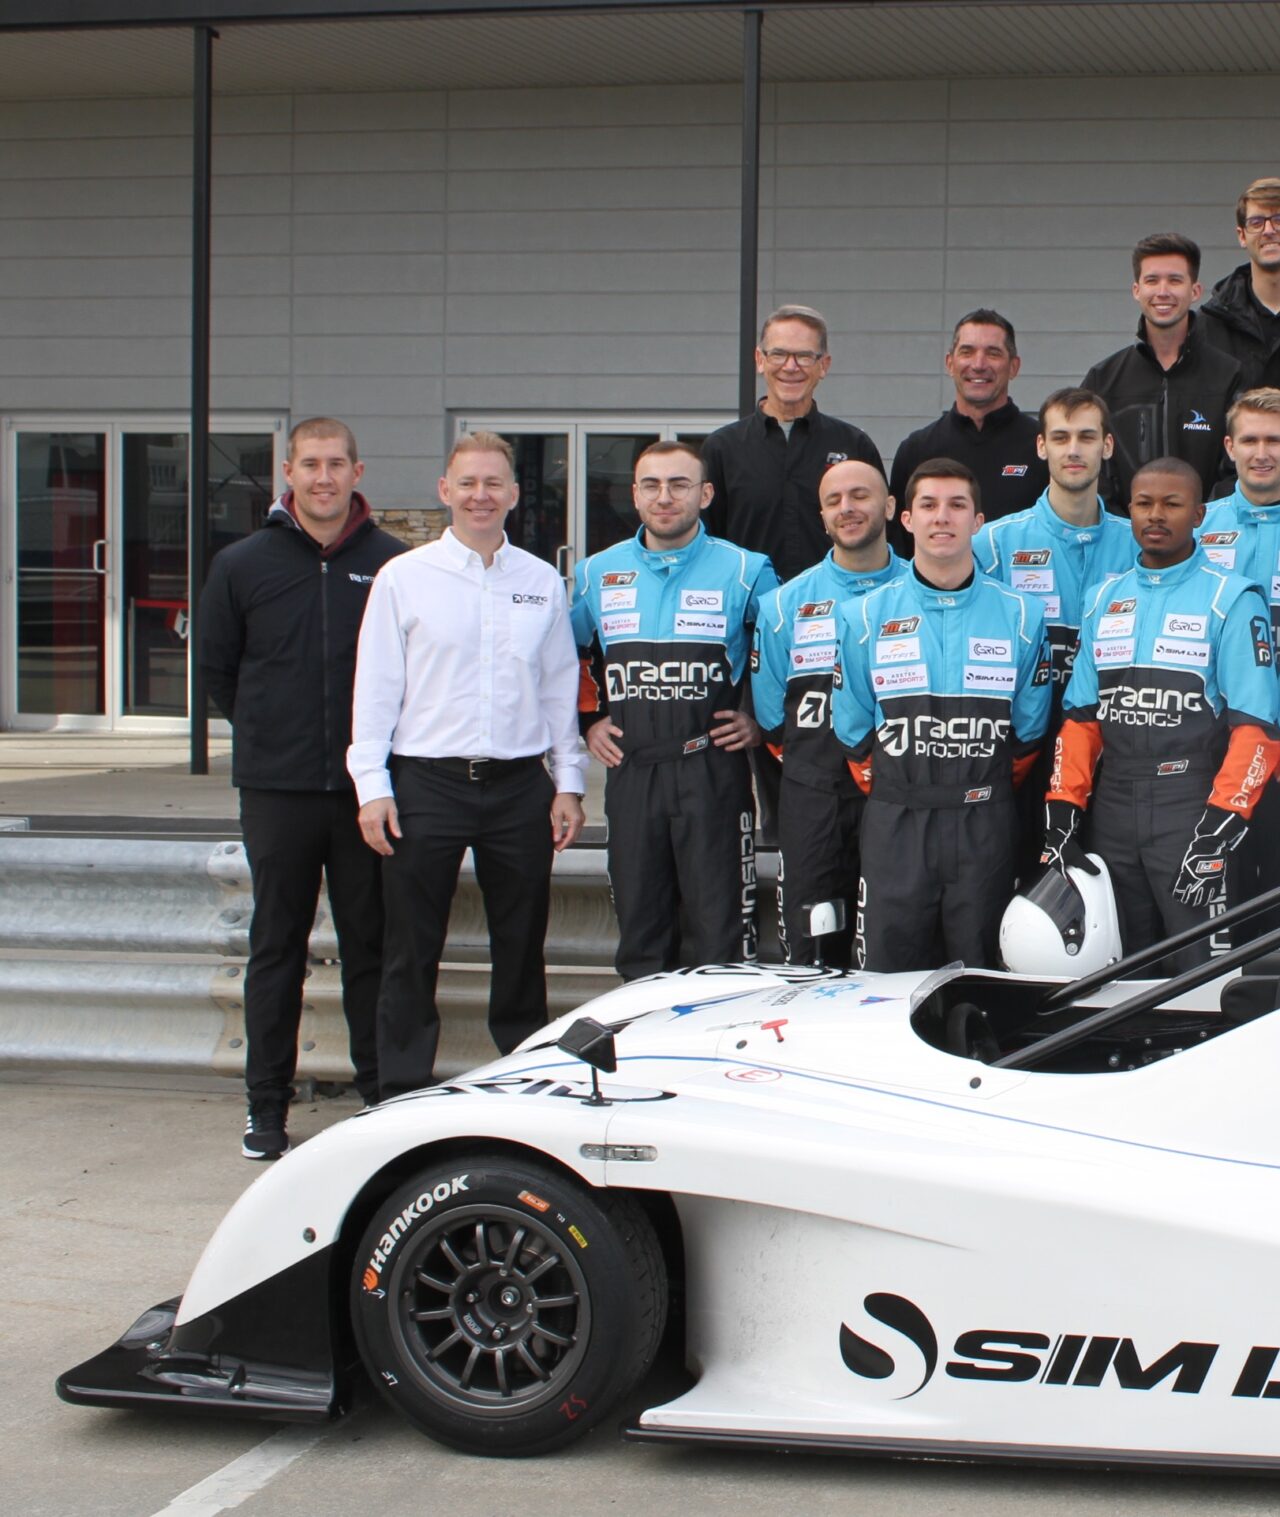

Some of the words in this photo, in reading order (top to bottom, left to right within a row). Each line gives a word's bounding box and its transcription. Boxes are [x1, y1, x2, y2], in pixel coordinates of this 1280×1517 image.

[1183, 423, 1211, 431] PRIMAL
[1205, 534, 1234, 544] MPI
[1017, 553, 1048, 564] MPI
[605, 573, 633, 585] MPI
[803, 603, 829, 615] MPI
[1109, 601, 1135, 614] MPI
[887, 619, 917, 633] MPI
[944, 1328, 1220, 1394] SIM
